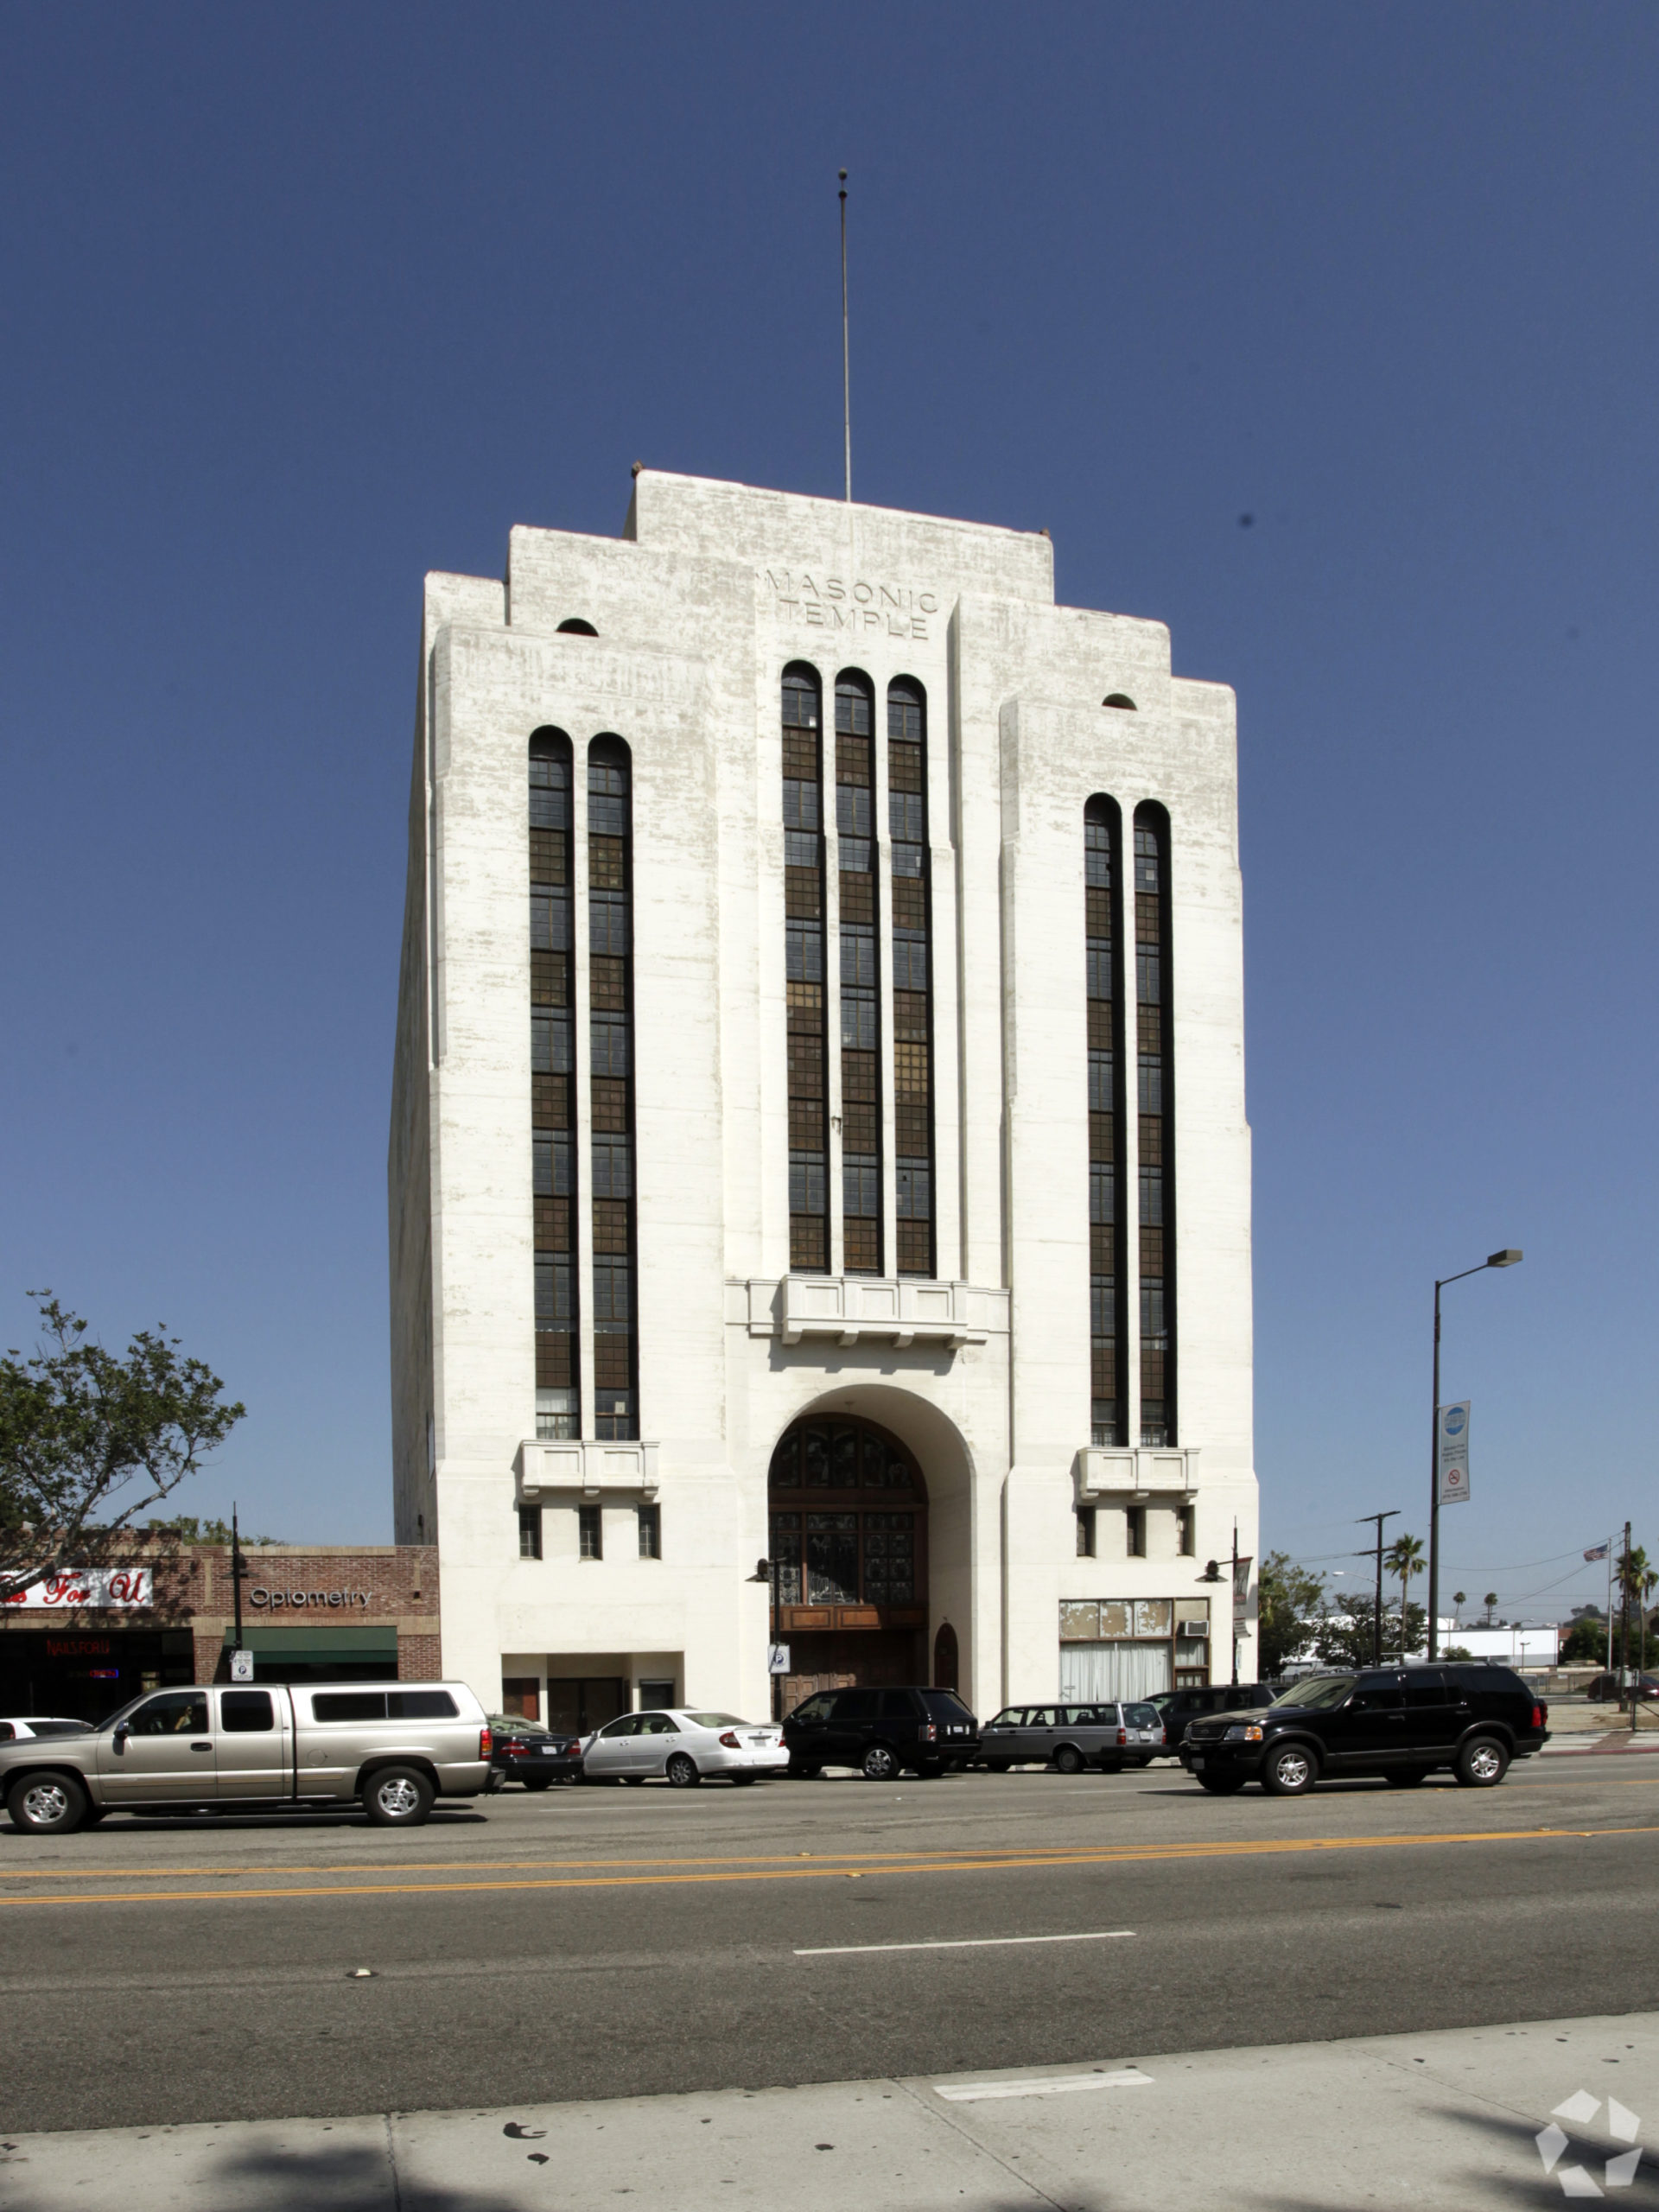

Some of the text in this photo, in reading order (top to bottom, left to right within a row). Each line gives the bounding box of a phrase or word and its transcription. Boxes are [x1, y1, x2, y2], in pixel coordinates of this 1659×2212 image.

[766, 569, 938, 613] MASONIC
[779, 598, 929, 640] TEMPLE
[43, 1572, 92, 1605] For
[109, 1572, 145, 1603] U
[251, 1587, 372, 1607] Optometry
